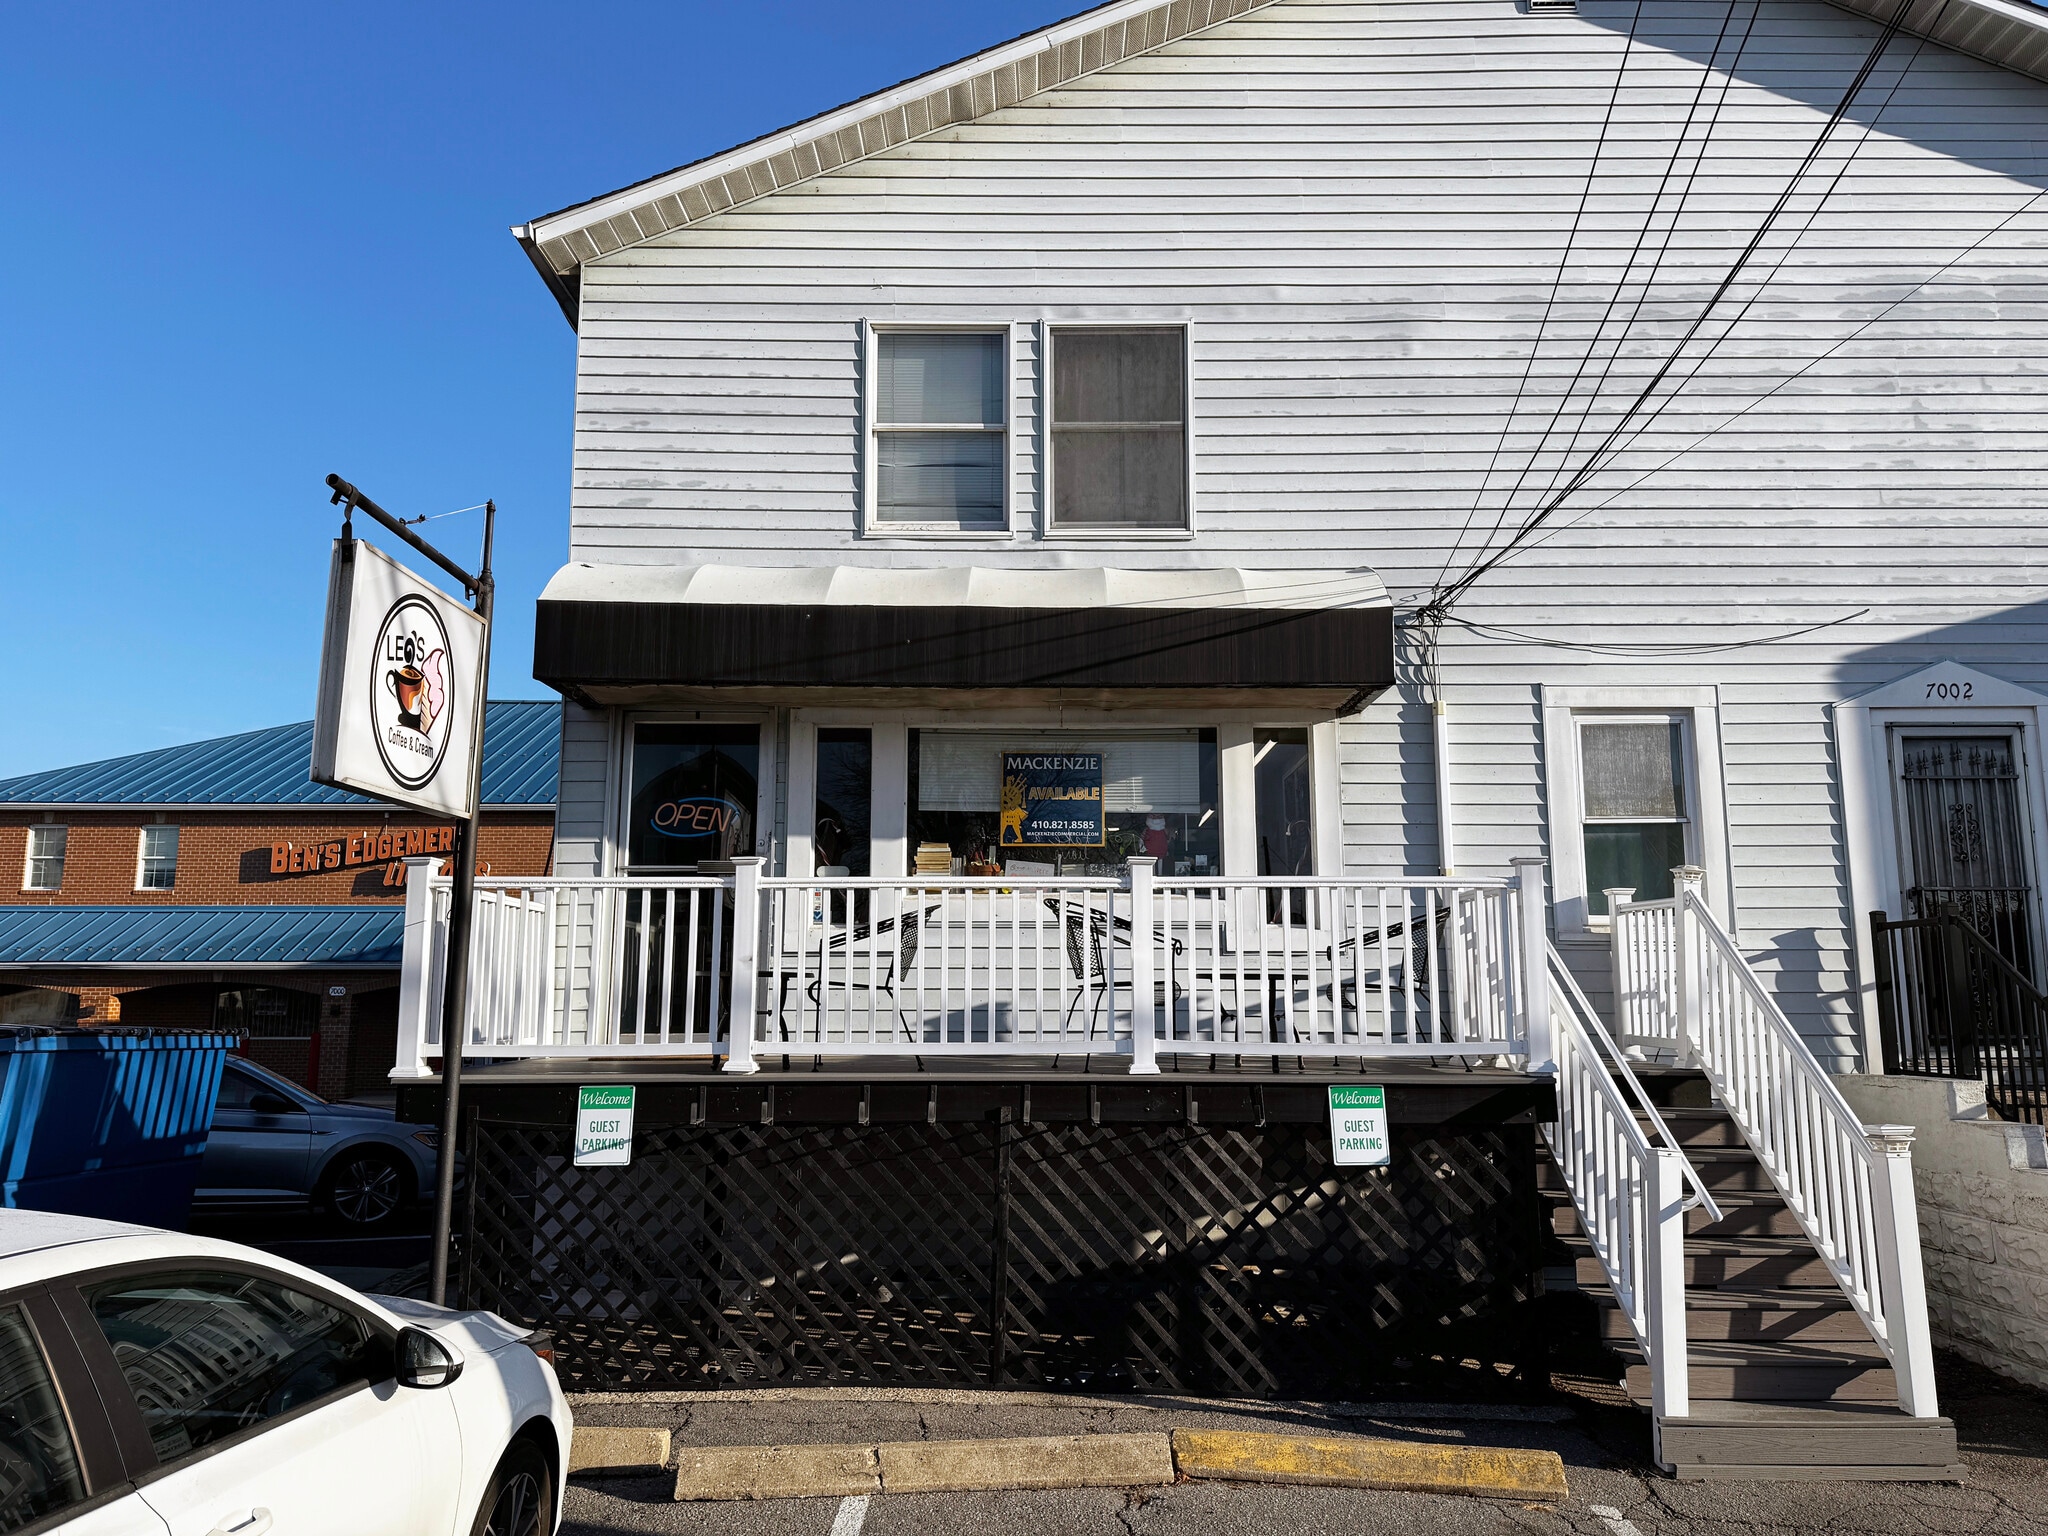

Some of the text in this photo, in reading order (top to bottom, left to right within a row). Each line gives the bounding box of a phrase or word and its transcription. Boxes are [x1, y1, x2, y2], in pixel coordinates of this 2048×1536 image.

[1926, 682, 1973, 699] 7002
[389, 727, 433, 758] Coffee & Cream
[1006, 757, 1098, 770] MACKENZIE
[1028, 787, 1099, 800] AVAILABLE
[655, 803, 732, 832] OPEN
[1031, 820, 1095, 829] 410.821.8585
[271, 827, 455, 873] BEN'S EDGEMER
[582, 1091, 630, 1105] Welcome
[1332, 1091, 1380, 1104] Welcome
[590, 1120, 620, 1132] GUEST
[1344, 1120, 1374, 1132] GUEST
[582, 1138, 625, 1150] PARKING
[1339, 1138, 1382, 1150] PARKING
